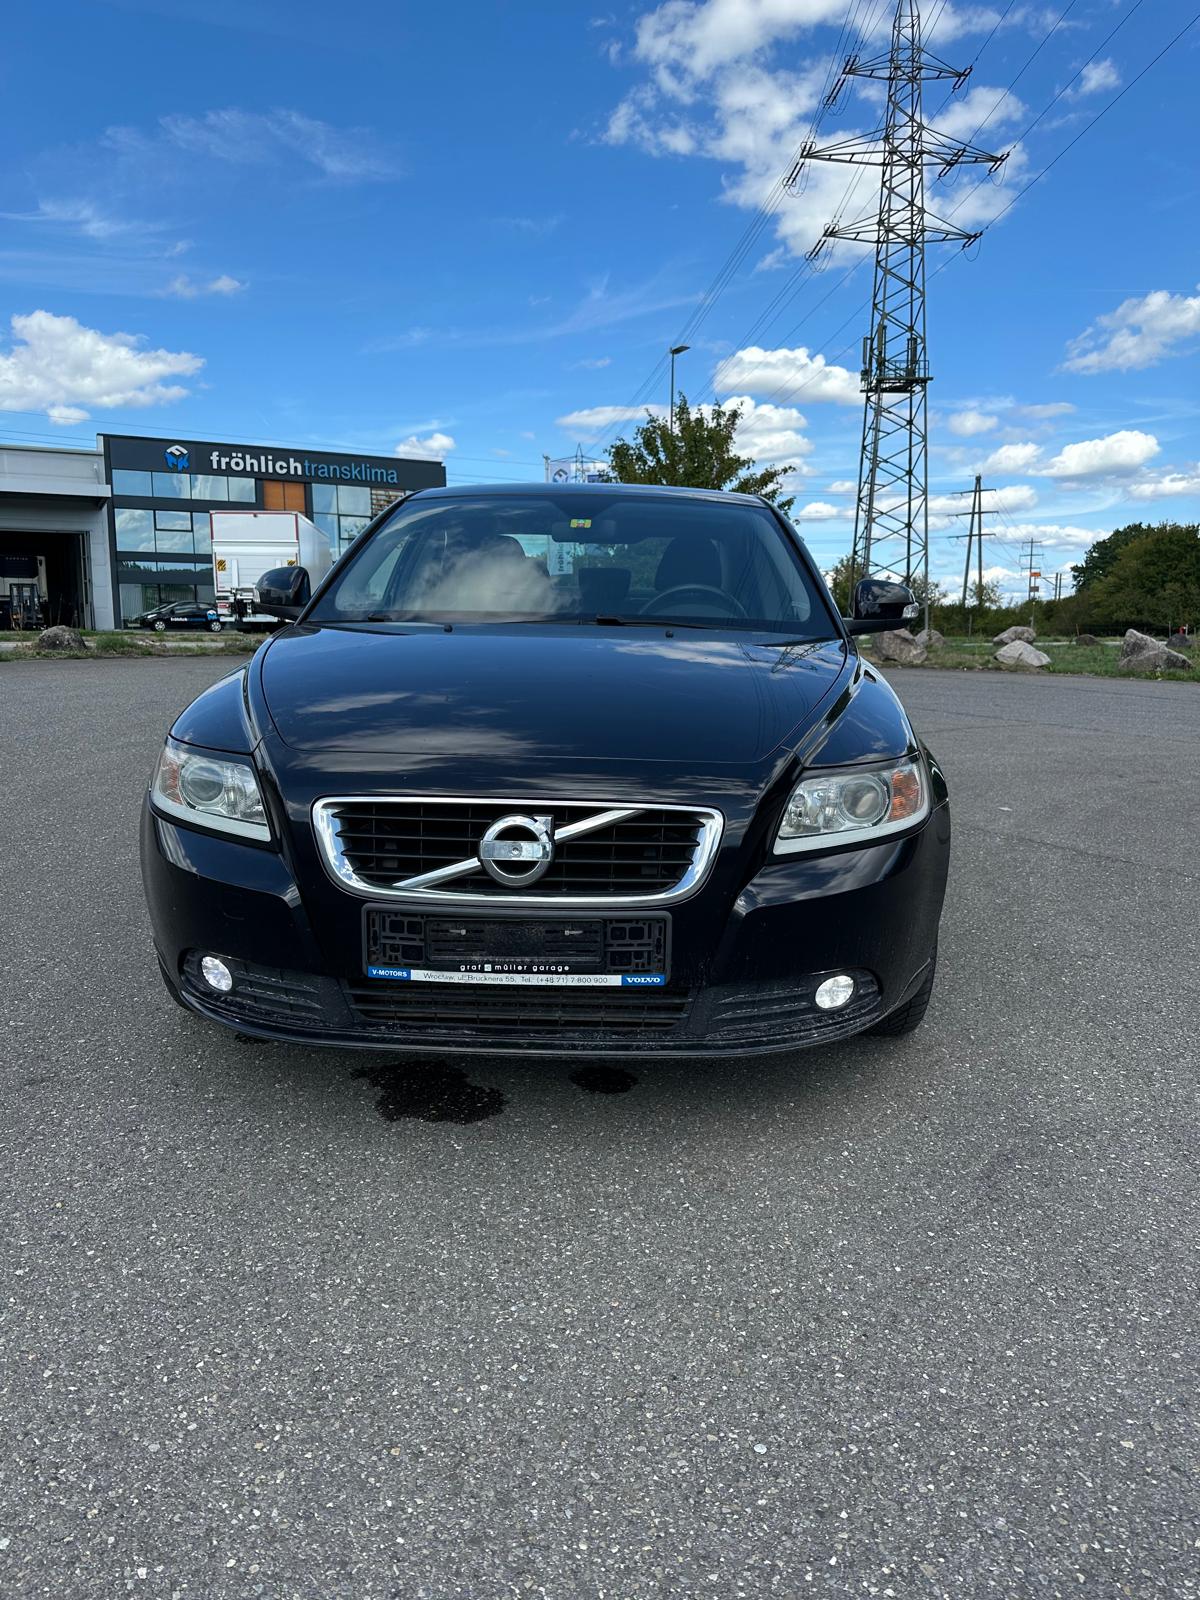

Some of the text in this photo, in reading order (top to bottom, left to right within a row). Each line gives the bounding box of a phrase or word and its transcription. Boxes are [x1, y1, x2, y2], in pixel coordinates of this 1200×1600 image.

[532, 964, 570, 972] garage
[372, 968, 408, 978] V-MOTORS
[536, 976, 554, 984] (+48
[577, 976, 592, 984] 800
[593, 976, 608, 984] 900
